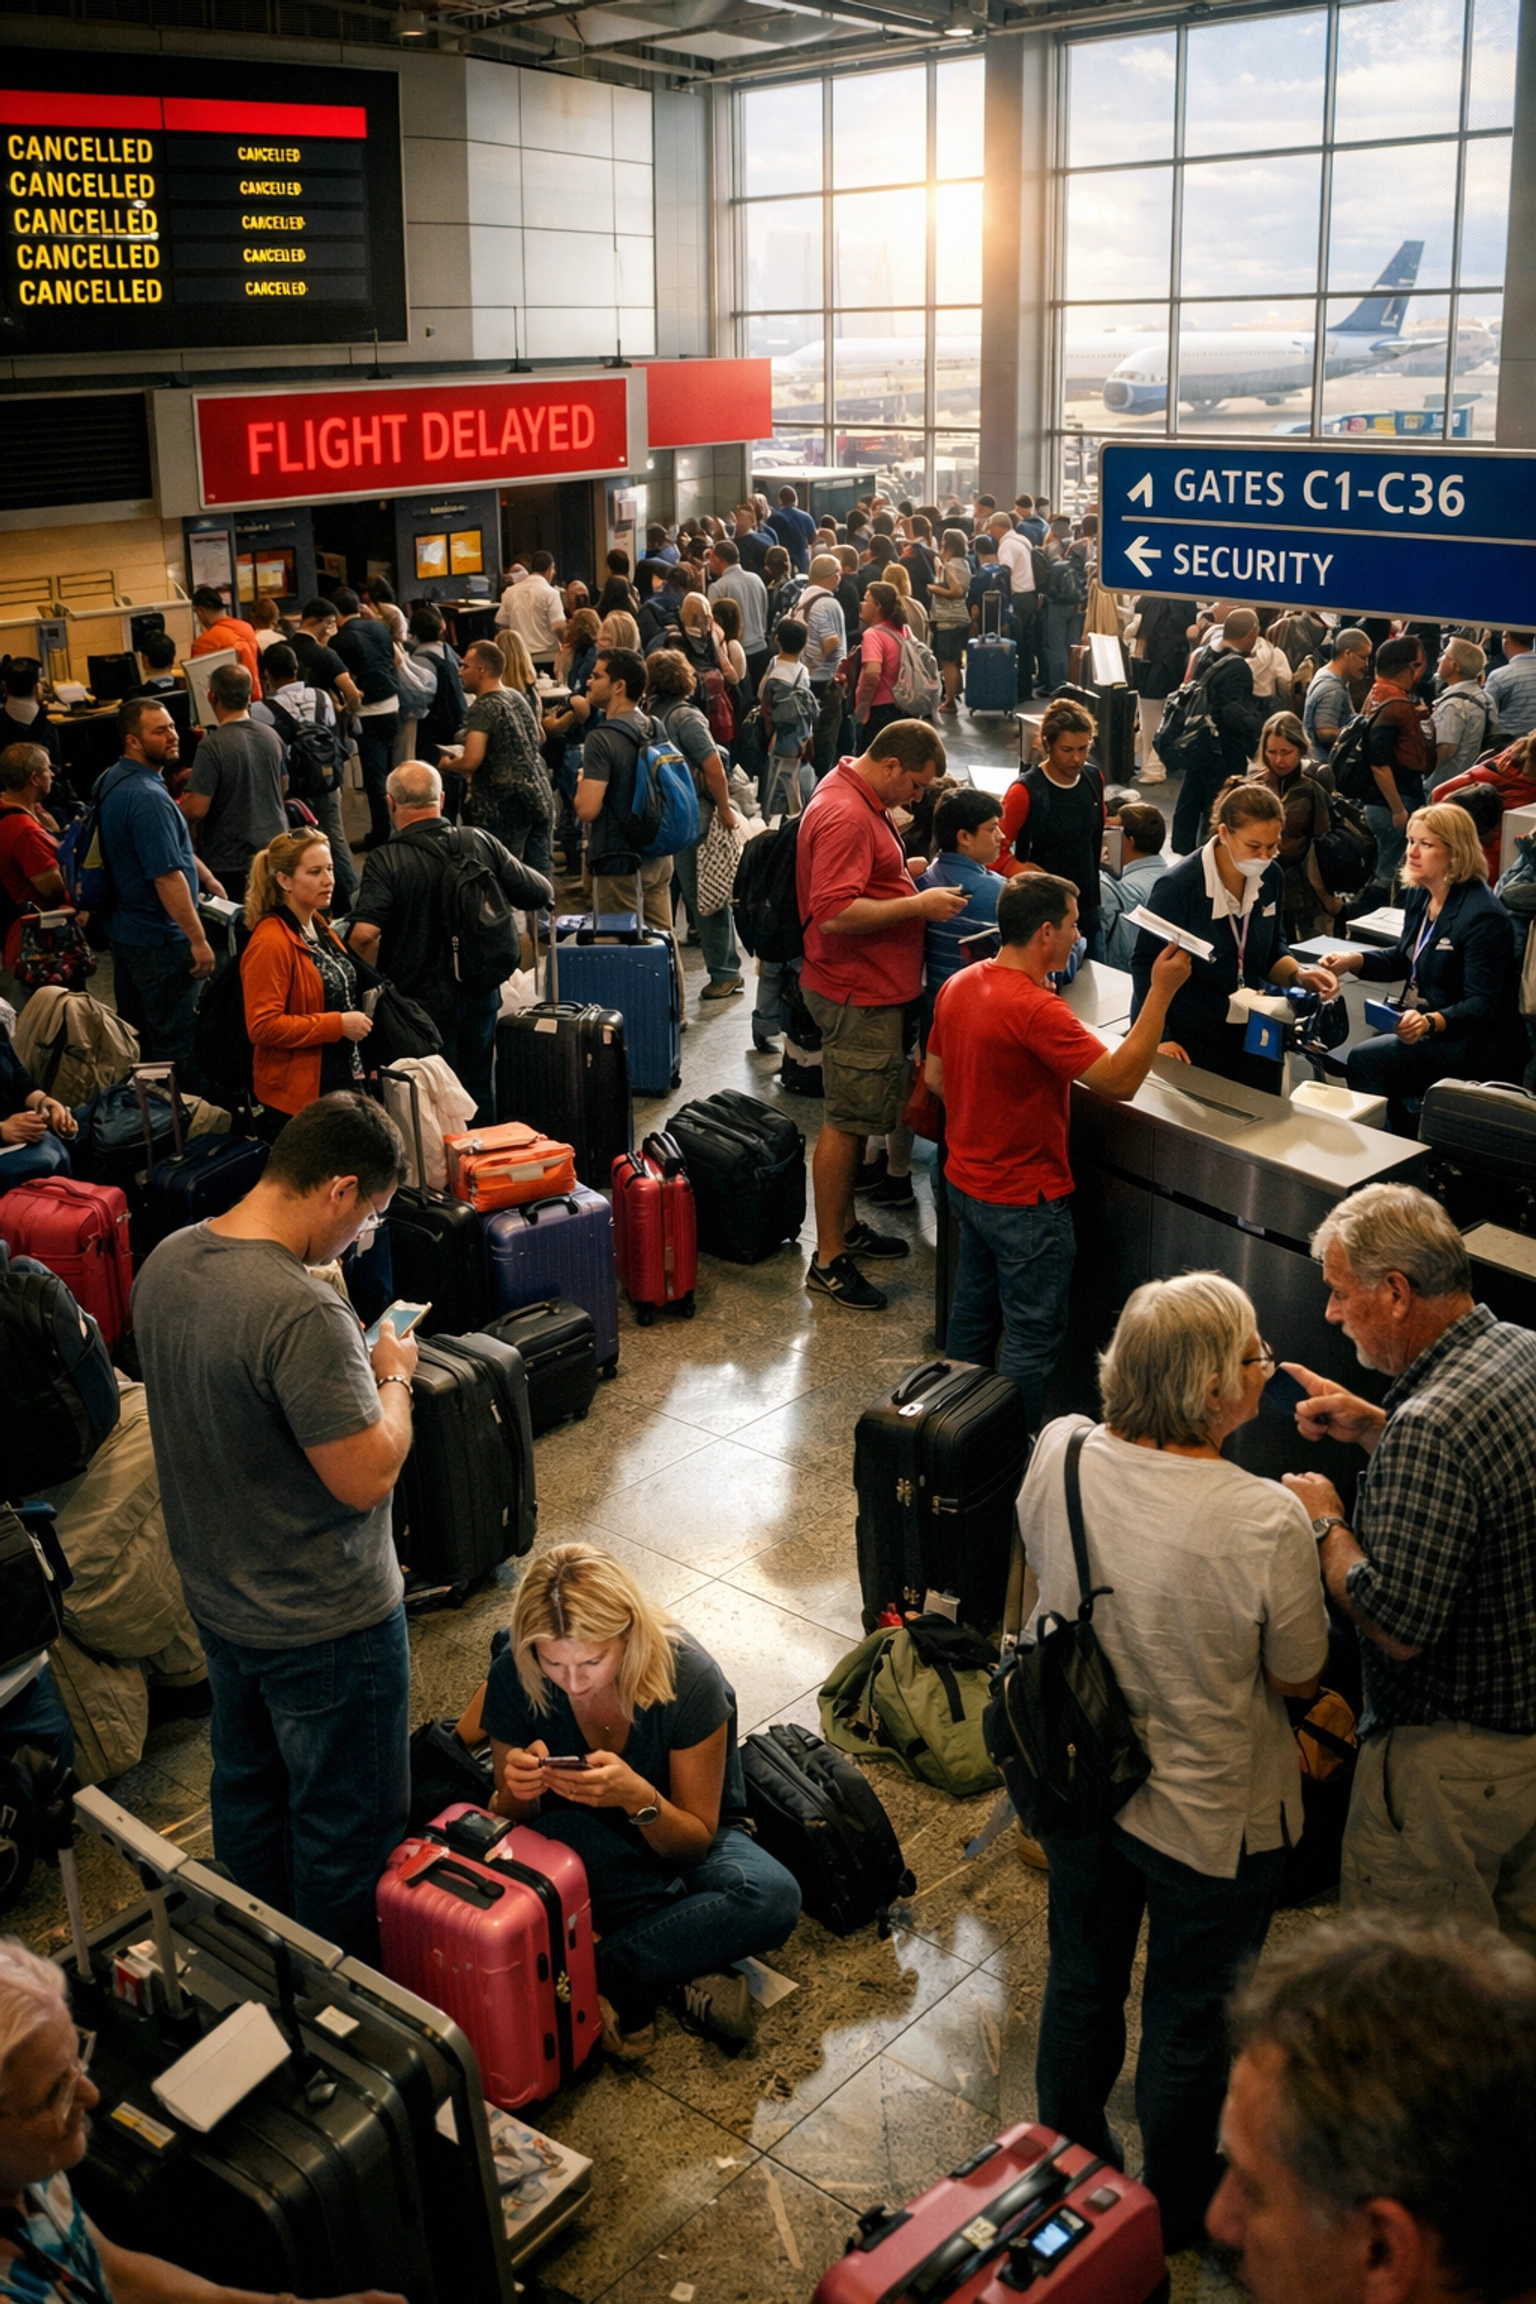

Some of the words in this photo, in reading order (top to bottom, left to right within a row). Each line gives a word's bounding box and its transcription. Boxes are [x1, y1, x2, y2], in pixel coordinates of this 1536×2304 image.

[8, 135, 153, 163] CANCELLED
[10, 172, 155, 198] CANCELLED
[14, 207, 158, 235] CANCELLED
[17, 244, 160, 269] CANCELLED
[19, 279, 163, 305] CANCELLED
[248, 414, 407, 475] FLIGHT
[422, 405, 596, 460] DELAYED
[1174, 468, 1285, 507] GATES
[1303, 470, 1466, 518] C1-C36
[1173, 543, 1334, 586] SECURITY
